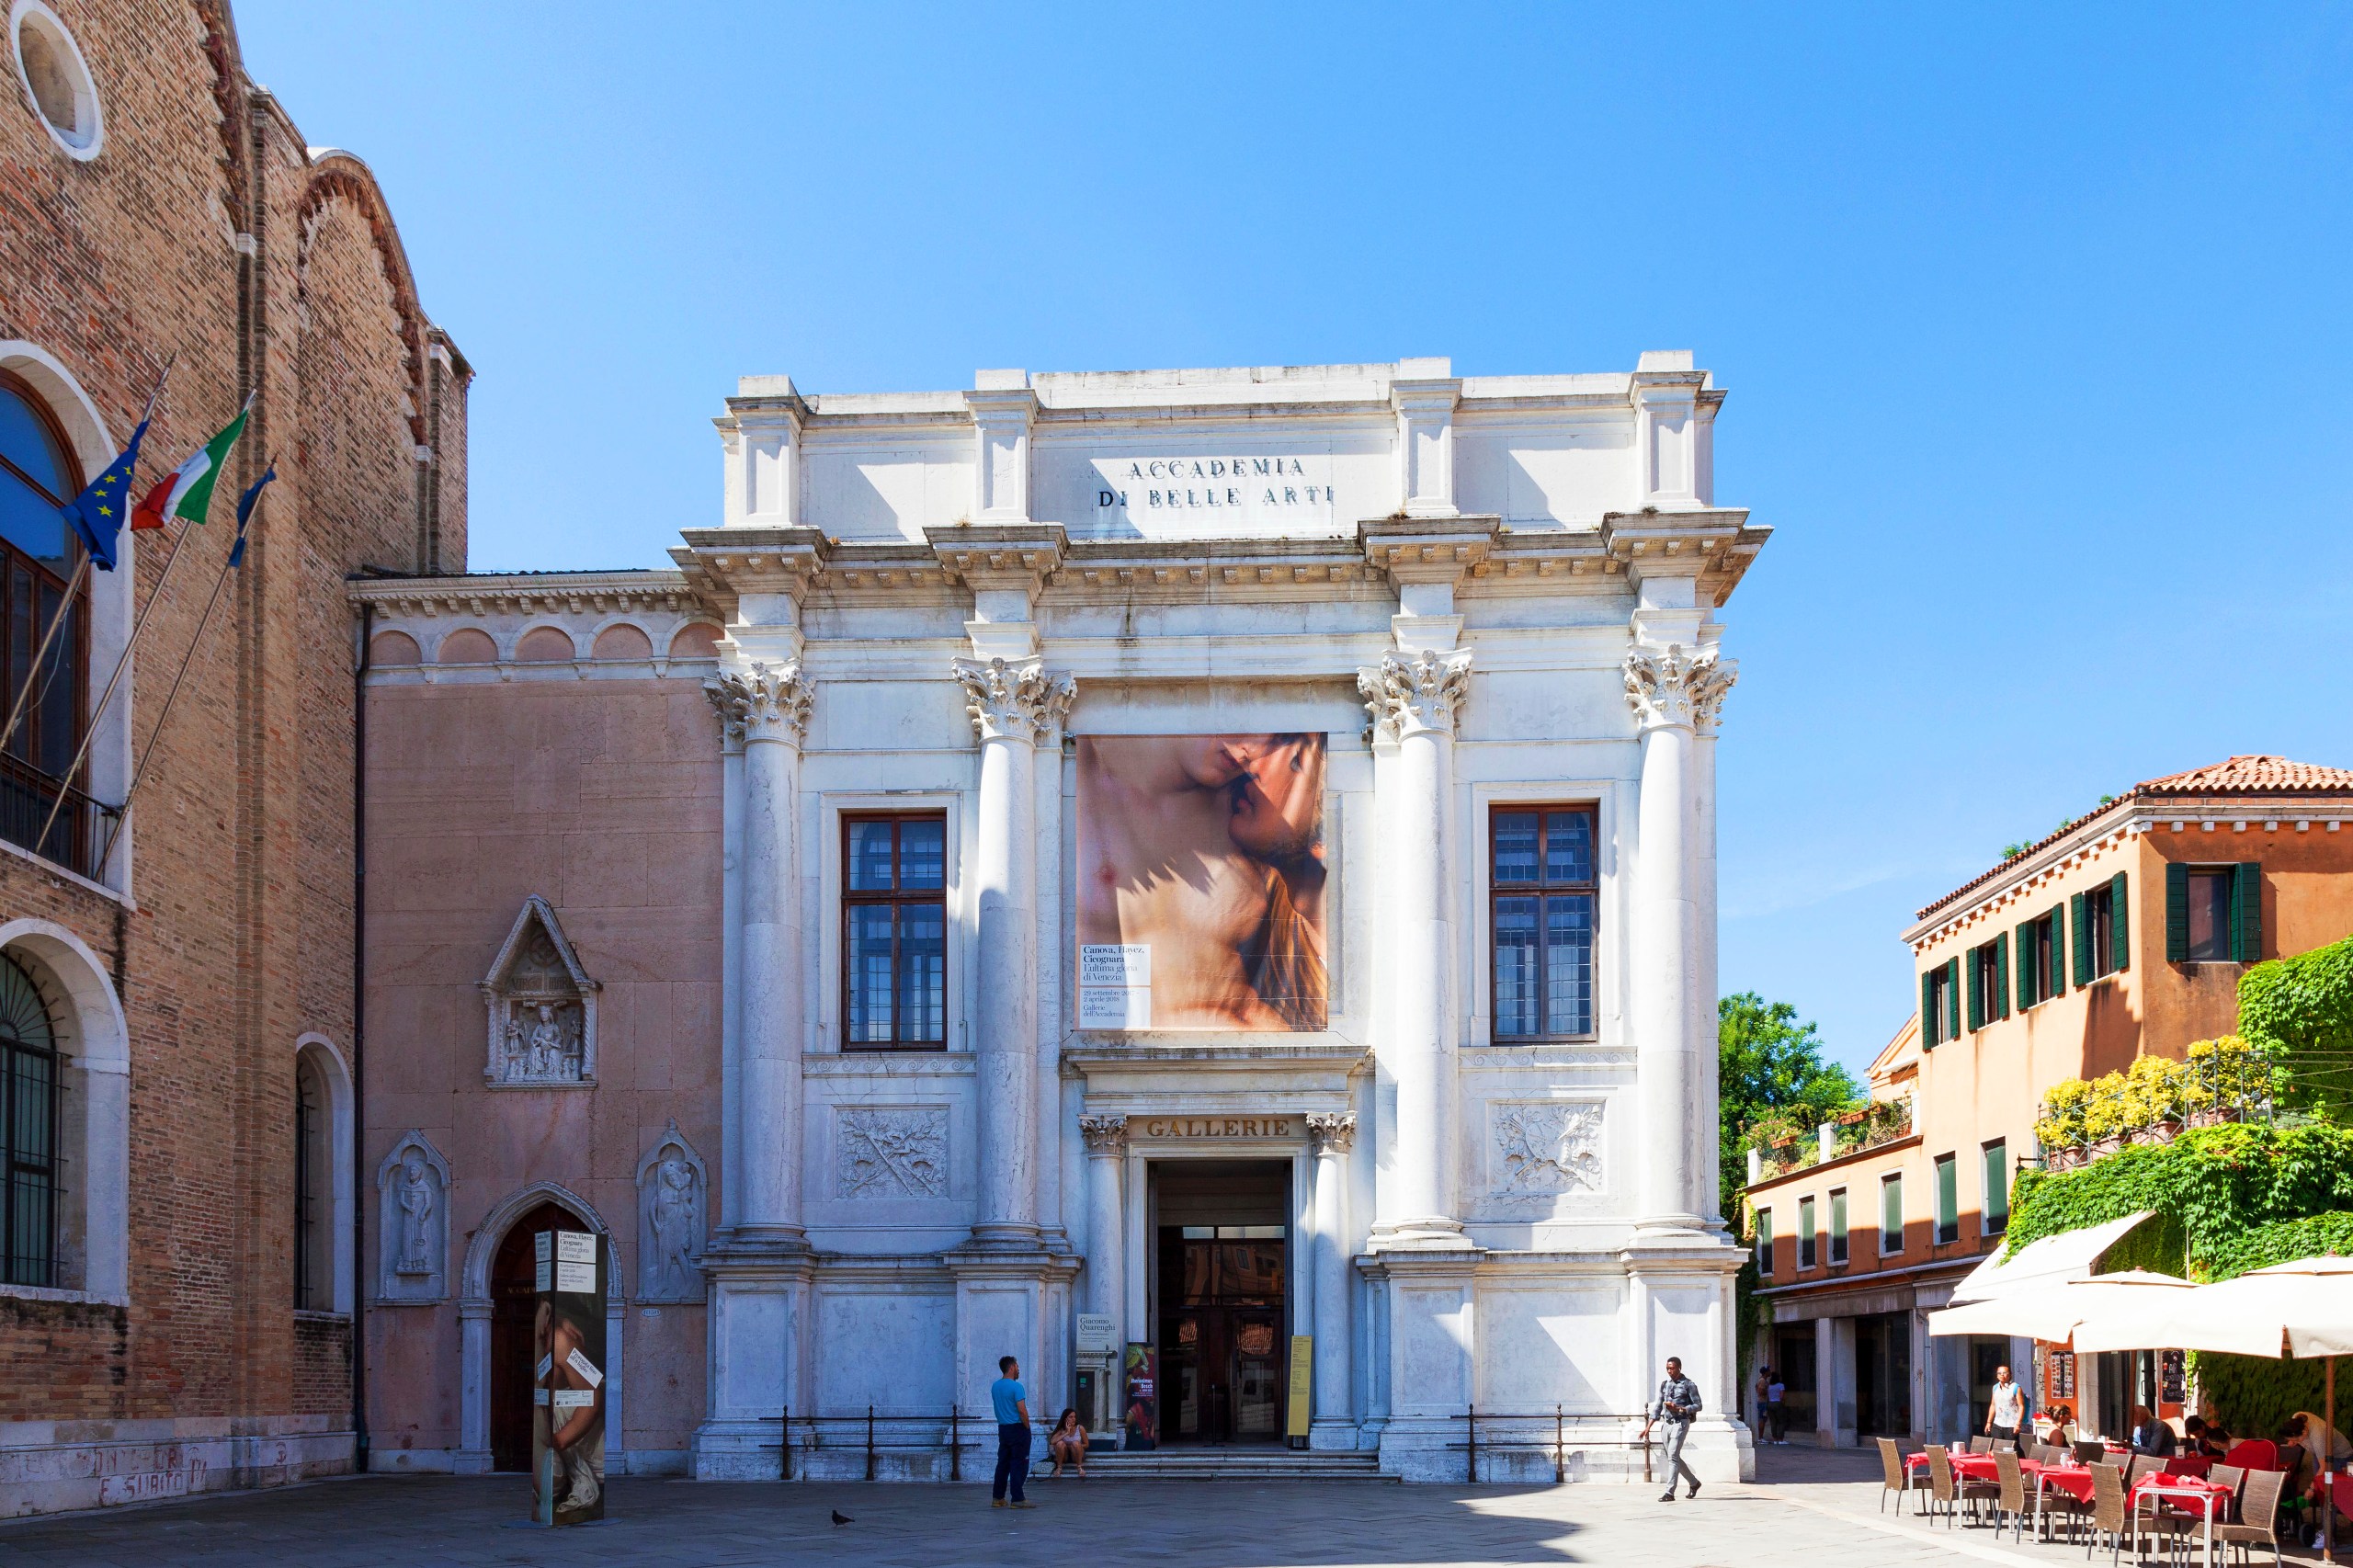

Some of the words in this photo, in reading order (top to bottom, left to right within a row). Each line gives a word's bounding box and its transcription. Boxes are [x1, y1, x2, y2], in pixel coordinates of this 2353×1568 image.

[1128, 458, 1304, 479] ACCADEMIA
[1097, 489, 1128, 507] DI
[1148, 488, 1241, 506] BELLE
[1262, 485, 1334, 506] ARTI
[1083, 946, 1116, 954] Canova,
[1118, 946, 1144, 955] Hayez,
[1083, 955, 1125, 964] Cicognara
[1083, 963, 1115, 972] L'ultima
[1083, 972, 1091, 981] di
[1093, 972, 1122, 981] Venezia
[1146, 1119, 1290, 1137] GALLERIE
[1079, 1324, 1116, 1332] Quarenghi
